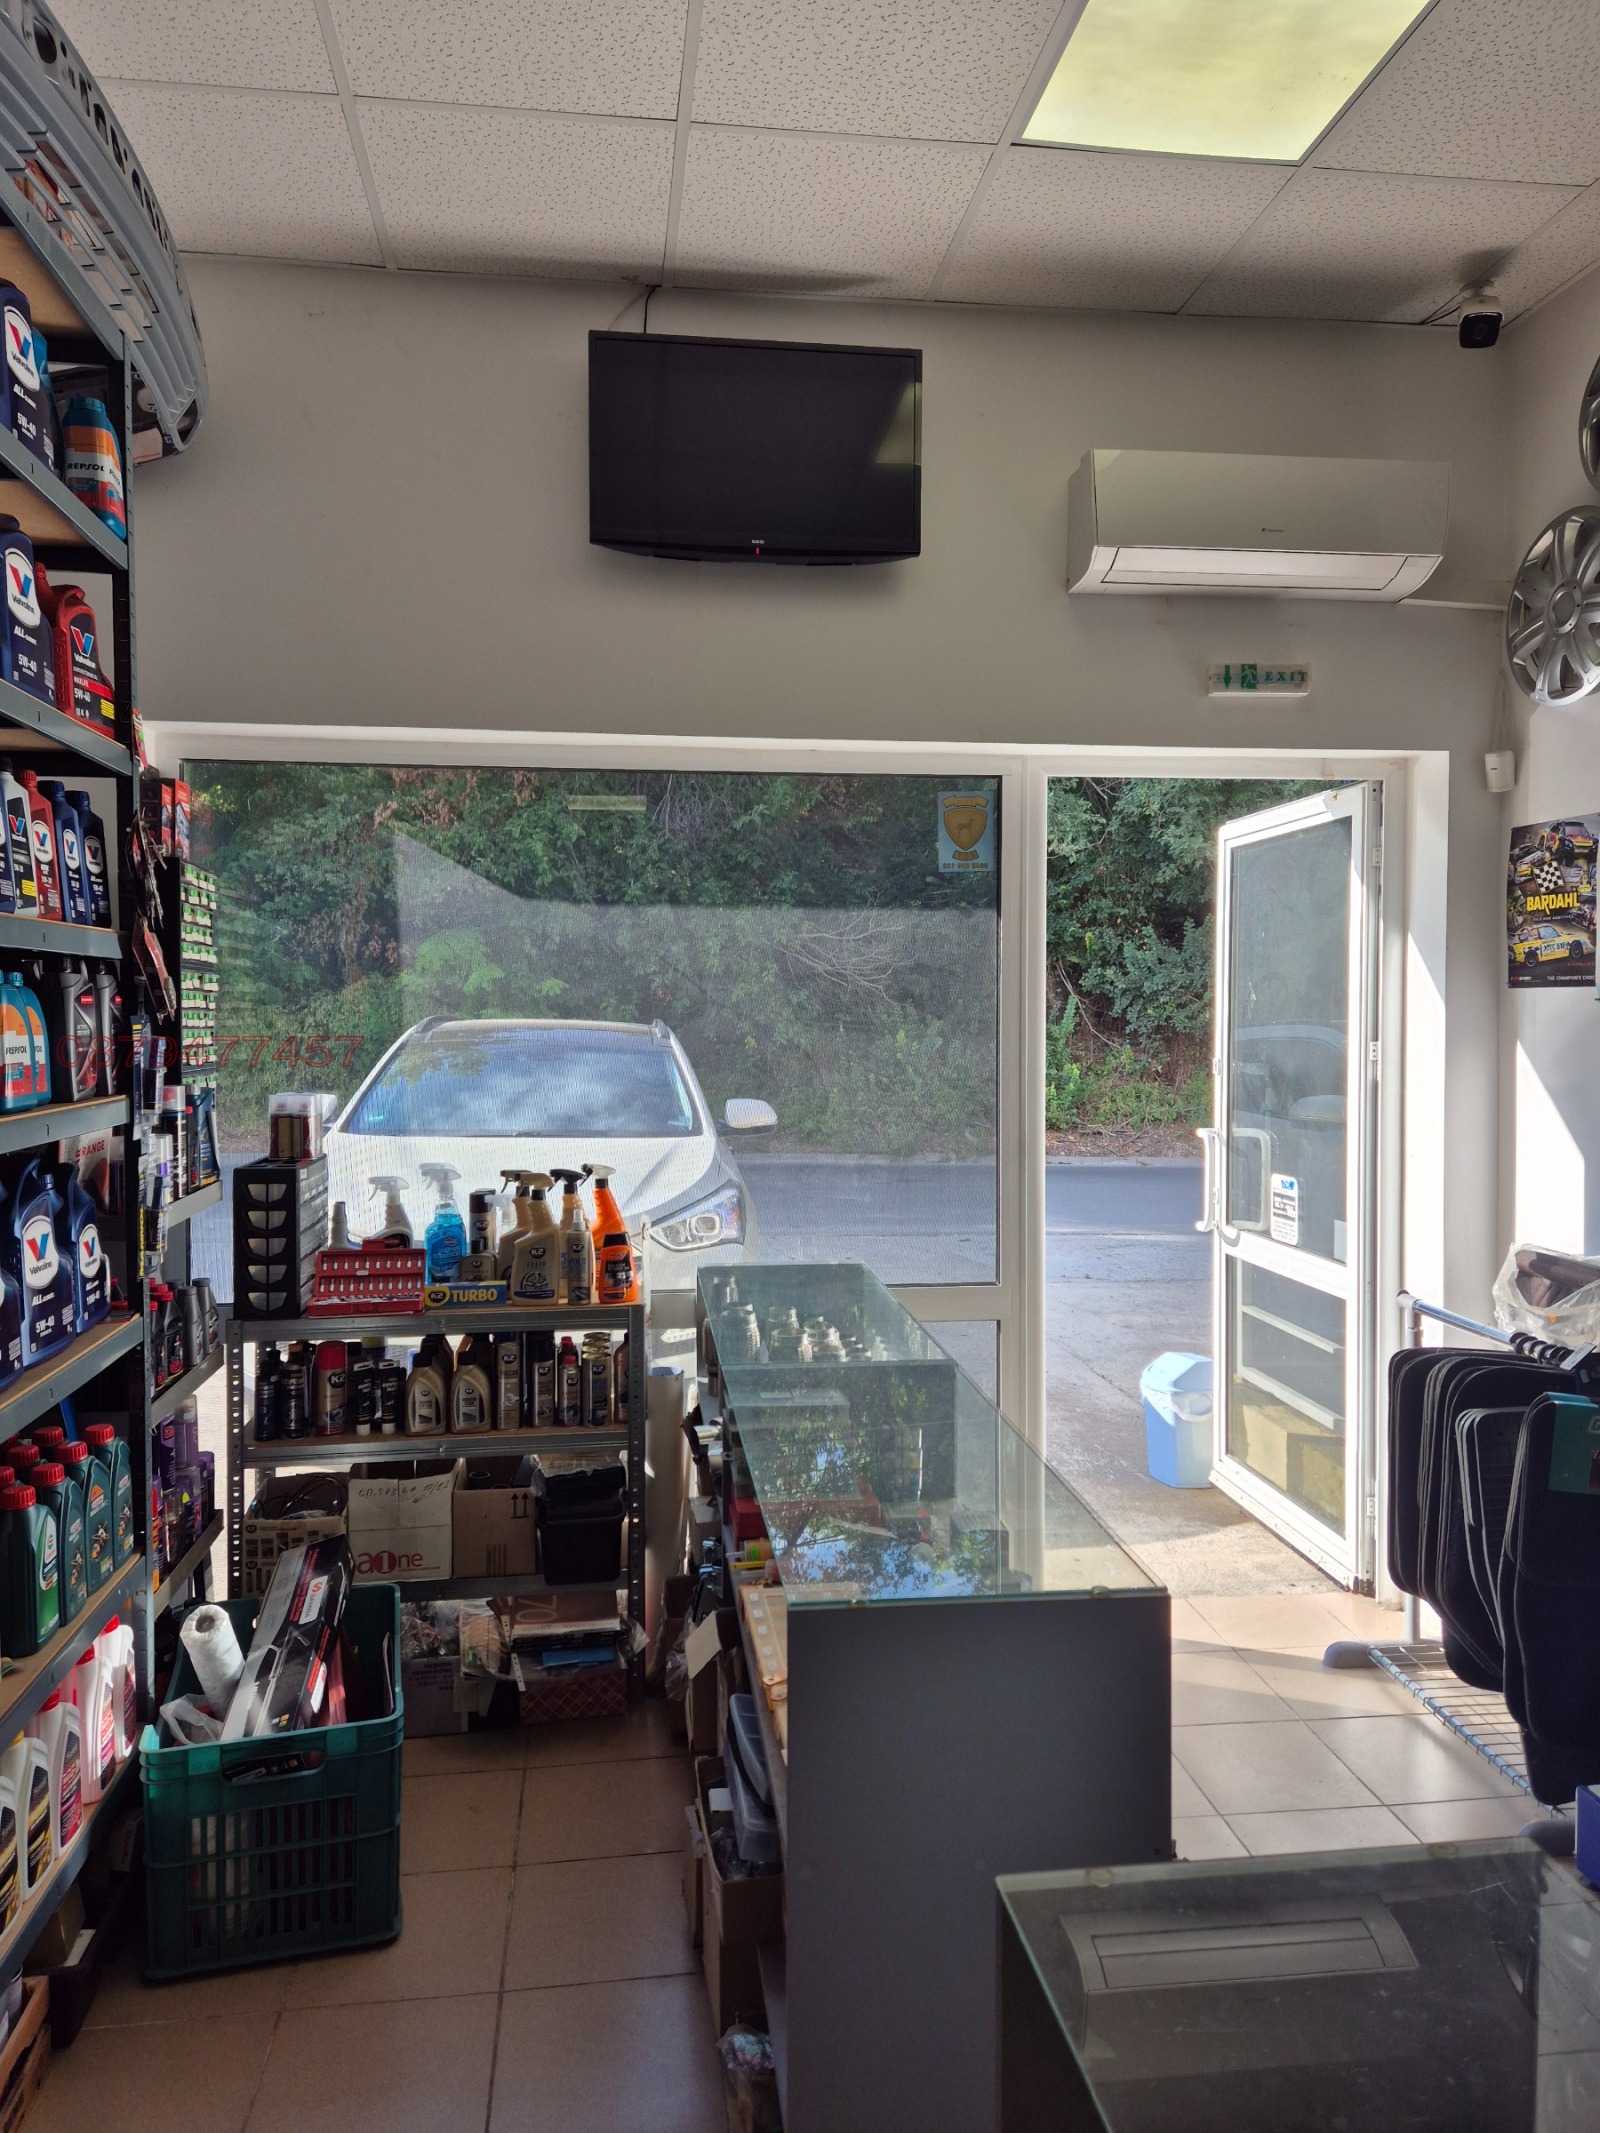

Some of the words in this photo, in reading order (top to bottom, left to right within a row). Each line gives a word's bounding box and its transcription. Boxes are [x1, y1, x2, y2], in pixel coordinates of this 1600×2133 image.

[67, 462, 104, 472] REPSOL
[1265, 671, 1307, 682] EXIT
[1526, 892, 1580, 916] BARDAHL
[6, 1045, 27, 1055] REPSOL
[29, 1261, 52, 1275] Valvoline
[430, 1291, 445, 1300] K2
[450, 1288, 498, 1302] TURBO
[503, 1353, 517, 1361] K2
[330, 1374, 346, 1385] K2
[567, 1377, 579, 1385] K2
